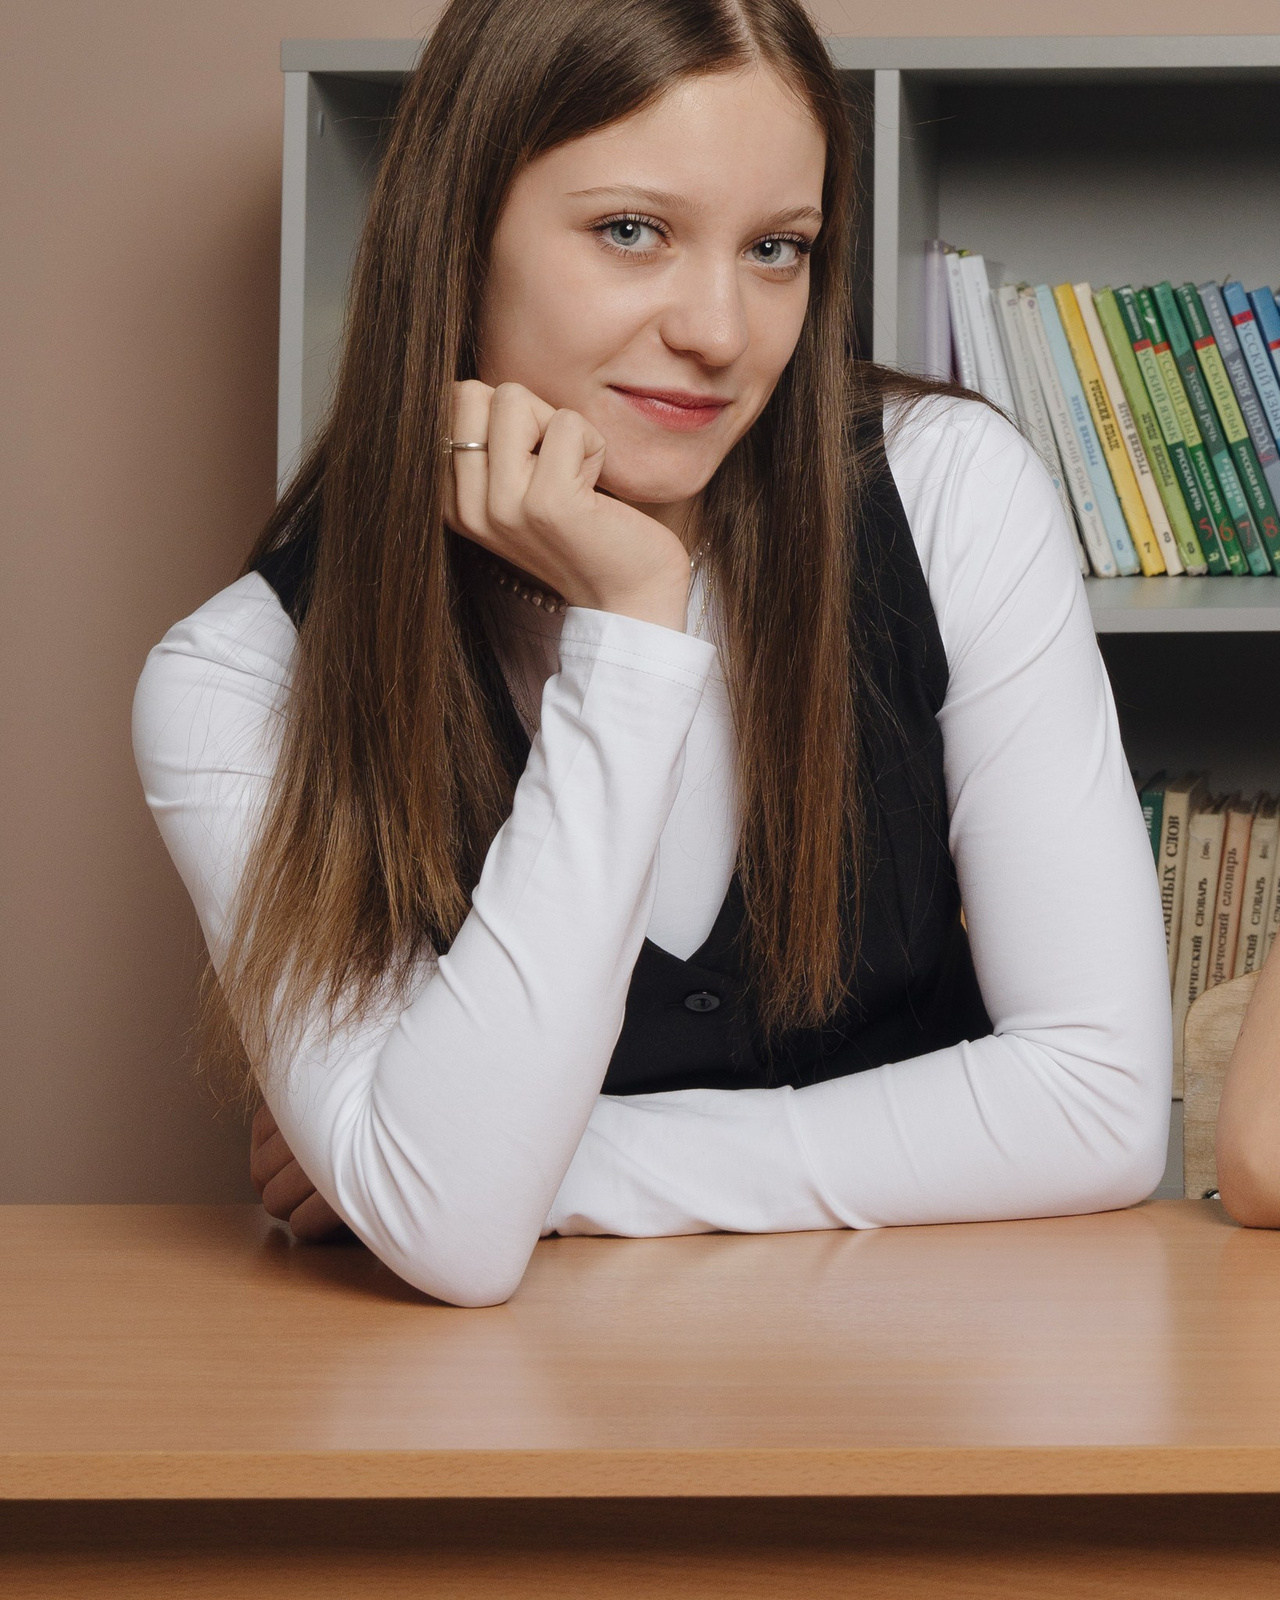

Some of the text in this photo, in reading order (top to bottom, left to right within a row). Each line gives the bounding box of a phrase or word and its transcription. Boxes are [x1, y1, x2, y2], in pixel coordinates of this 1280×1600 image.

[1057, 411, 1081, 464] РУССКИЙ
[1069, 394, 1099, 466] РУССКИЙ ЯЗЫК
[1086, 378, 1122, 451] РУССКИЙ ЯЗЫК
[1116, 401, 1149, 476] РУССКИЙ ЯЗЫК
[1159, 404, 1179, 441] ЯЗЫК
[1178, 407, 1198, 443] ЯЗЫК
[1199, 412, 1219, 443] речь
[1221, 402, 1241, 438] ЯЗЫК
[1140, 411, 1174, 487] РУССКИЙ ЯЗЫК
[1174, 447, 1204, 512] РУССКАЯ РЕЧЬ
[1194, 449, 1223, 514] РУССКАЯ РЕЧЬ
[1237, 444, 1267, 510] РУССКАЯ РЕЧЬ
[1143, 541, 1151, 553] 7
[1199, 517, 1213, 540] 5
[1219, 518, 1234, 541] 6
[1237, 521, 1251, 546] 7
[1263, 516, 1278, 538] 8
[1165, 814, 1180, 857] СЛОВ
[1220, 846, 1240, 907] словарь
[1250, 875, 1265, 925] СЛОВАРЬ
[1186, 876, 1207, 1006] ФИЧЕСКИЙ СЛОВАРЬ
